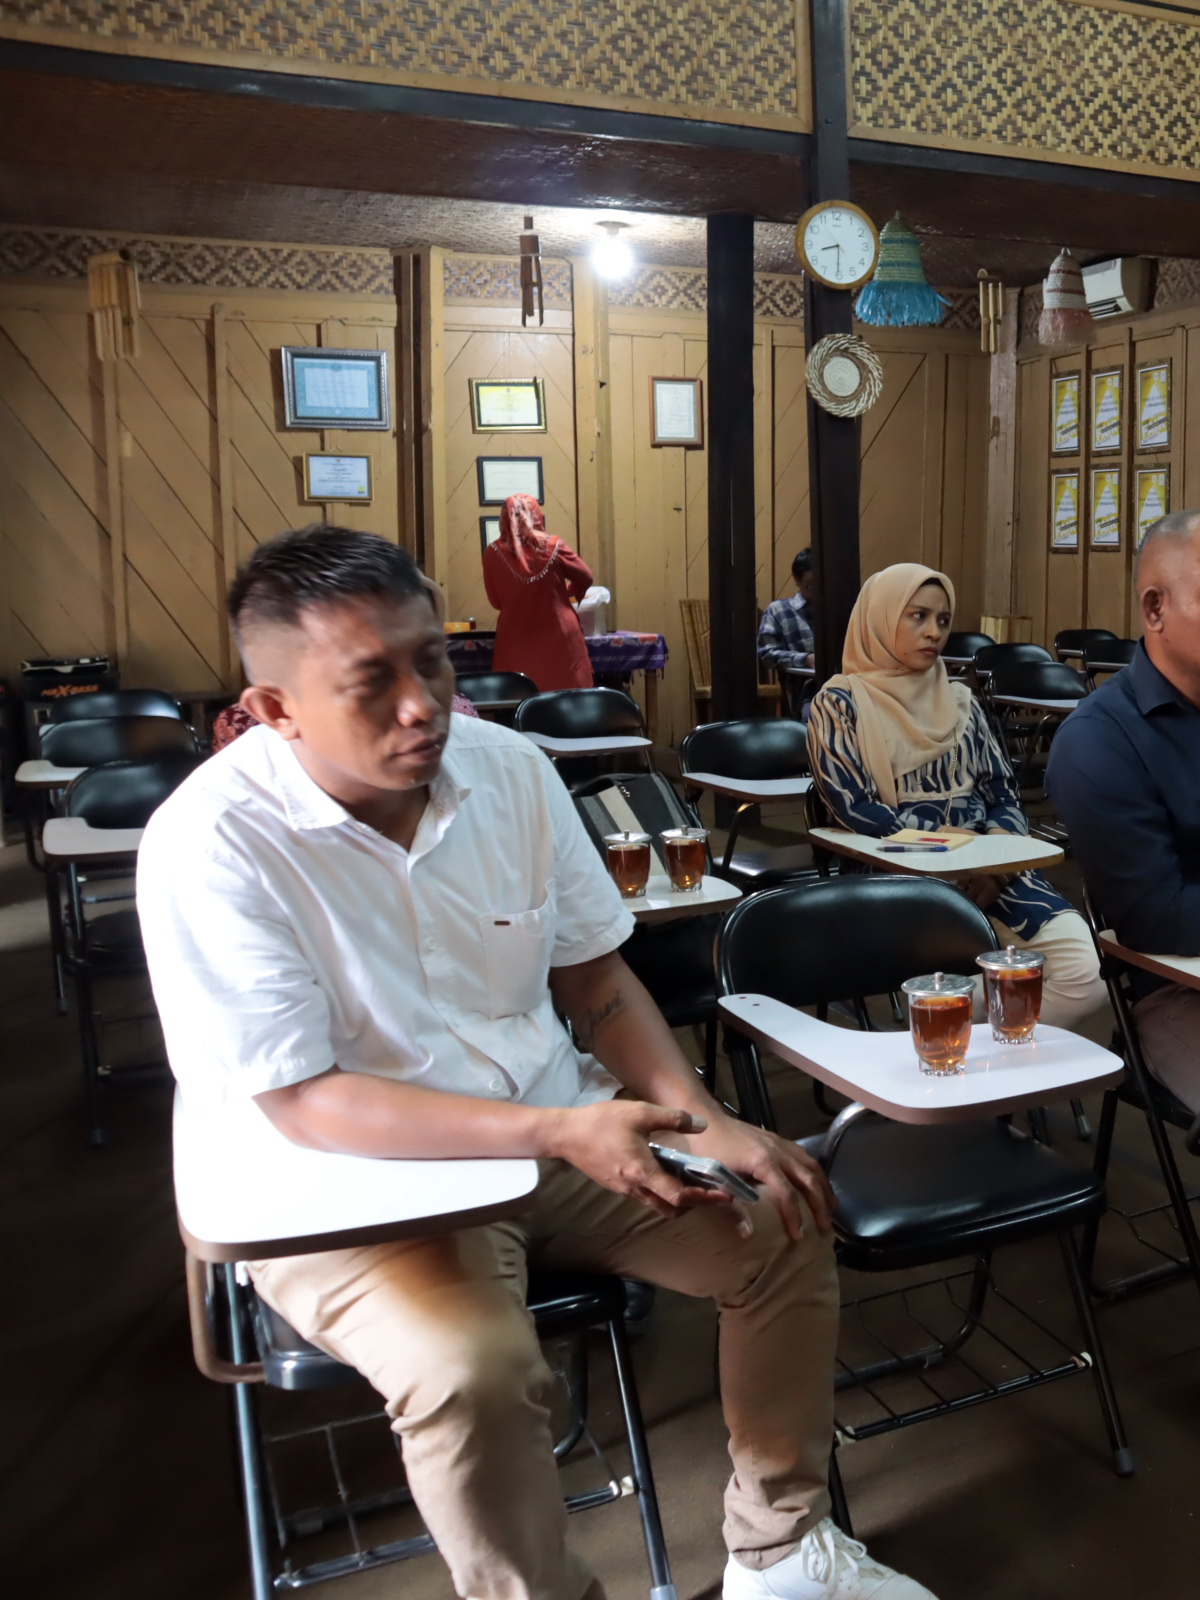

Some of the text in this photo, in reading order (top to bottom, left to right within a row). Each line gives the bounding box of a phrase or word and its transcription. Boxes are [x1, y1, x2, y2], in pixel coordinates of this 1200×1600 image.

[820, 216, 826, 224] 11
[832, 211, 841, 220] 12
[810, 225, 819, 234] 10
[858, 228, 864, 237] 2
[806, 240, 812, 249] 9
[862, 242, 868, 251] 3
[811, 256, 818, 265] 8
[821, 266, 827, 274] 7
[850, 267, 856, 276] 5
[836, 271, 843, 280] 6
